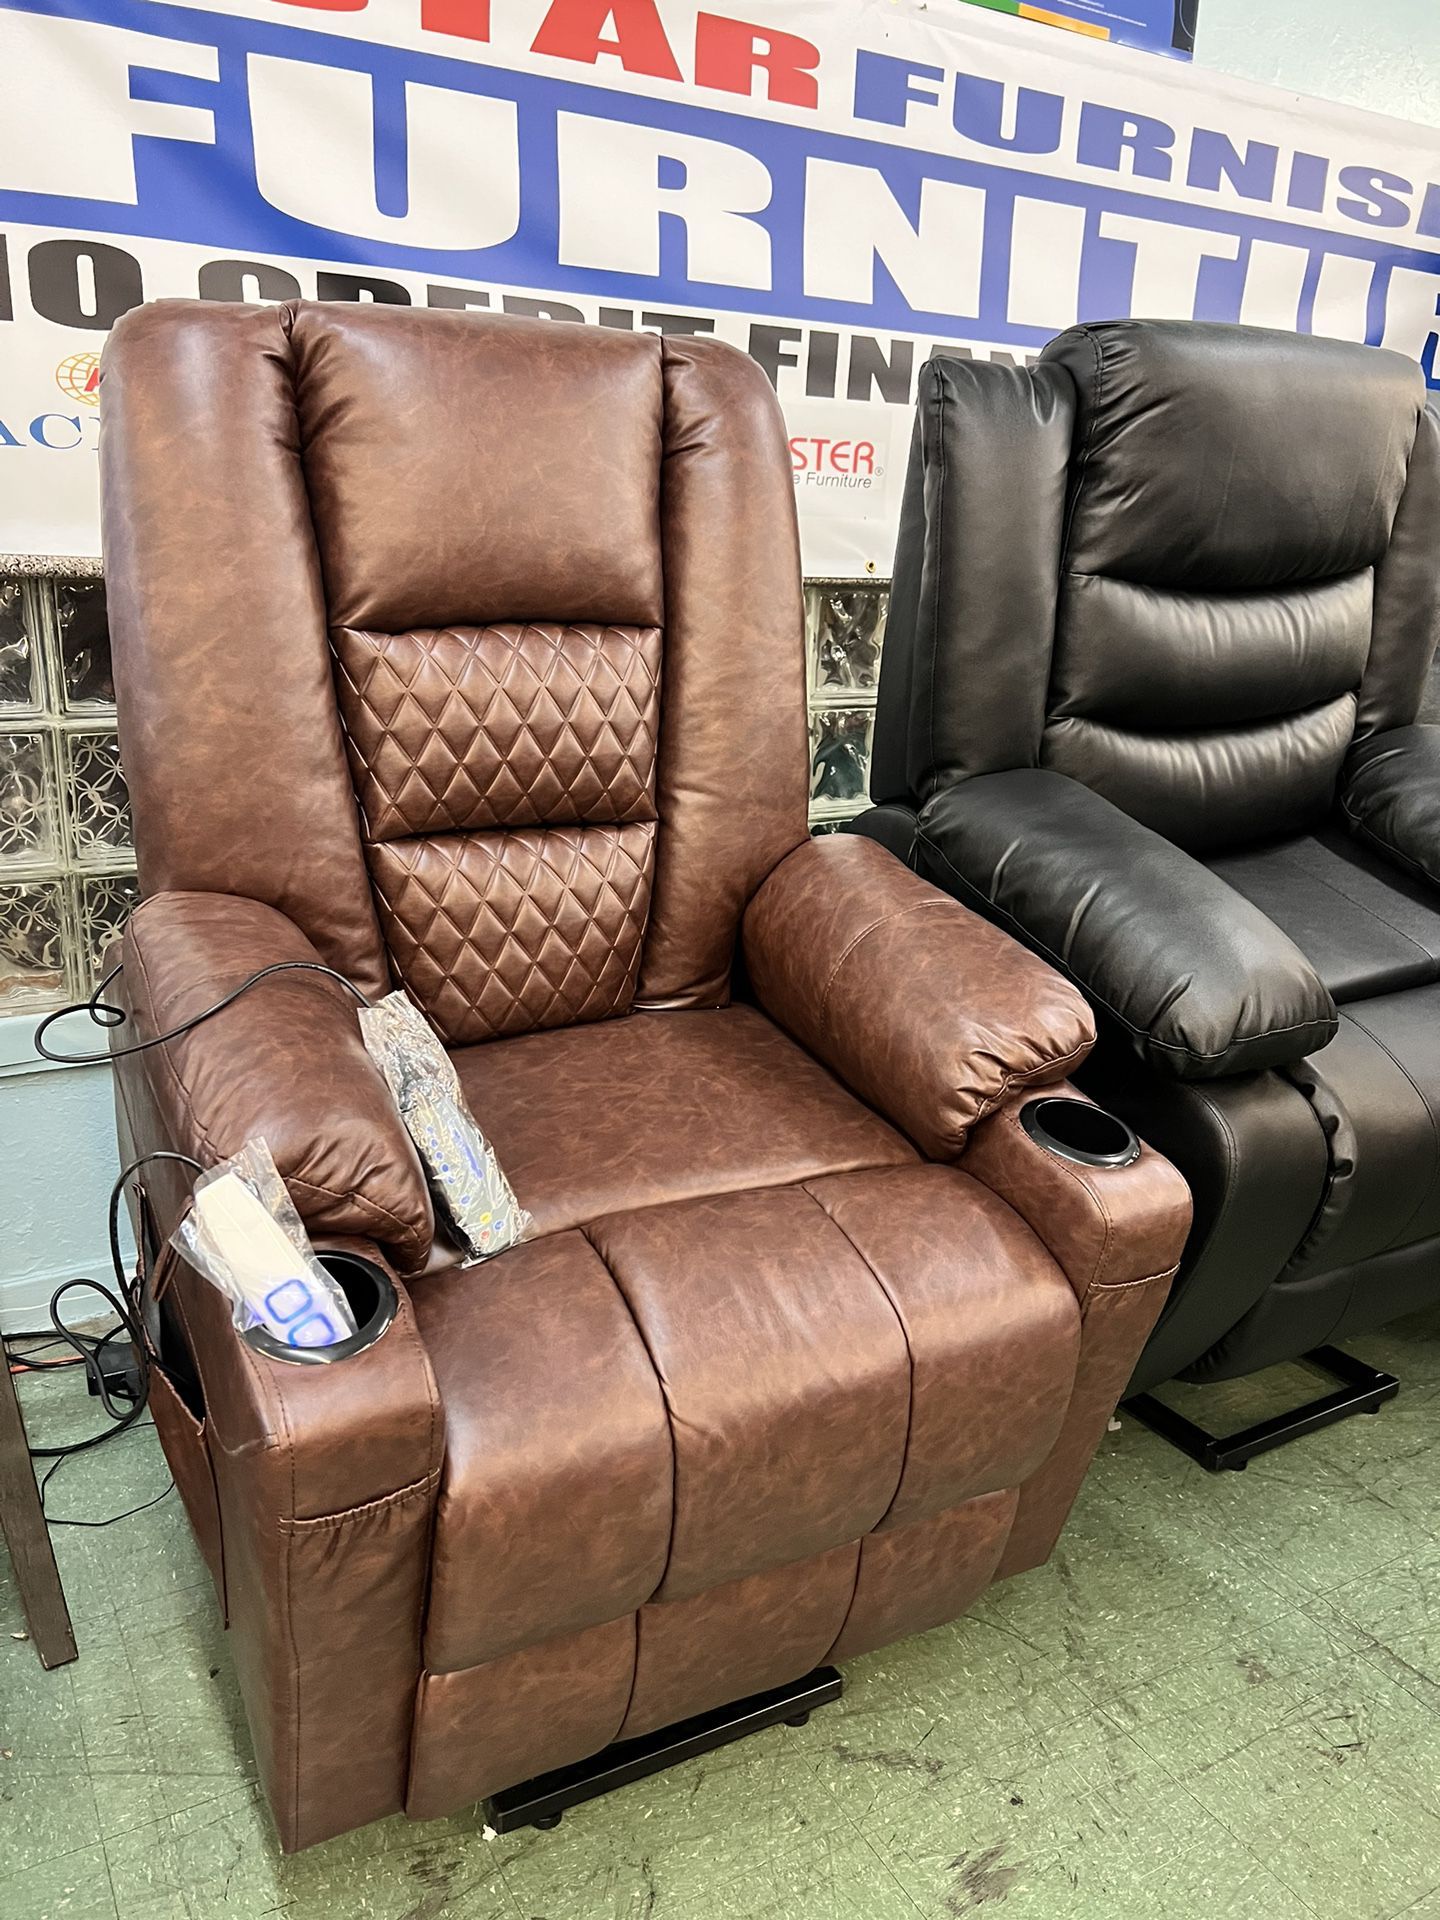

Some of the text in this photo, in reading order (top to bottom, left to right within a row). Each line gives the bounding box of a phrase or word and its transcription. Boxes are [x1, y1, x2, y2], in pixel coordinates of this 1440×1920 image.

[853, 48, 1440, 239] FURNIS
[0, 233, 144, 331] O
[806, 471, 872, 489] Furniture
